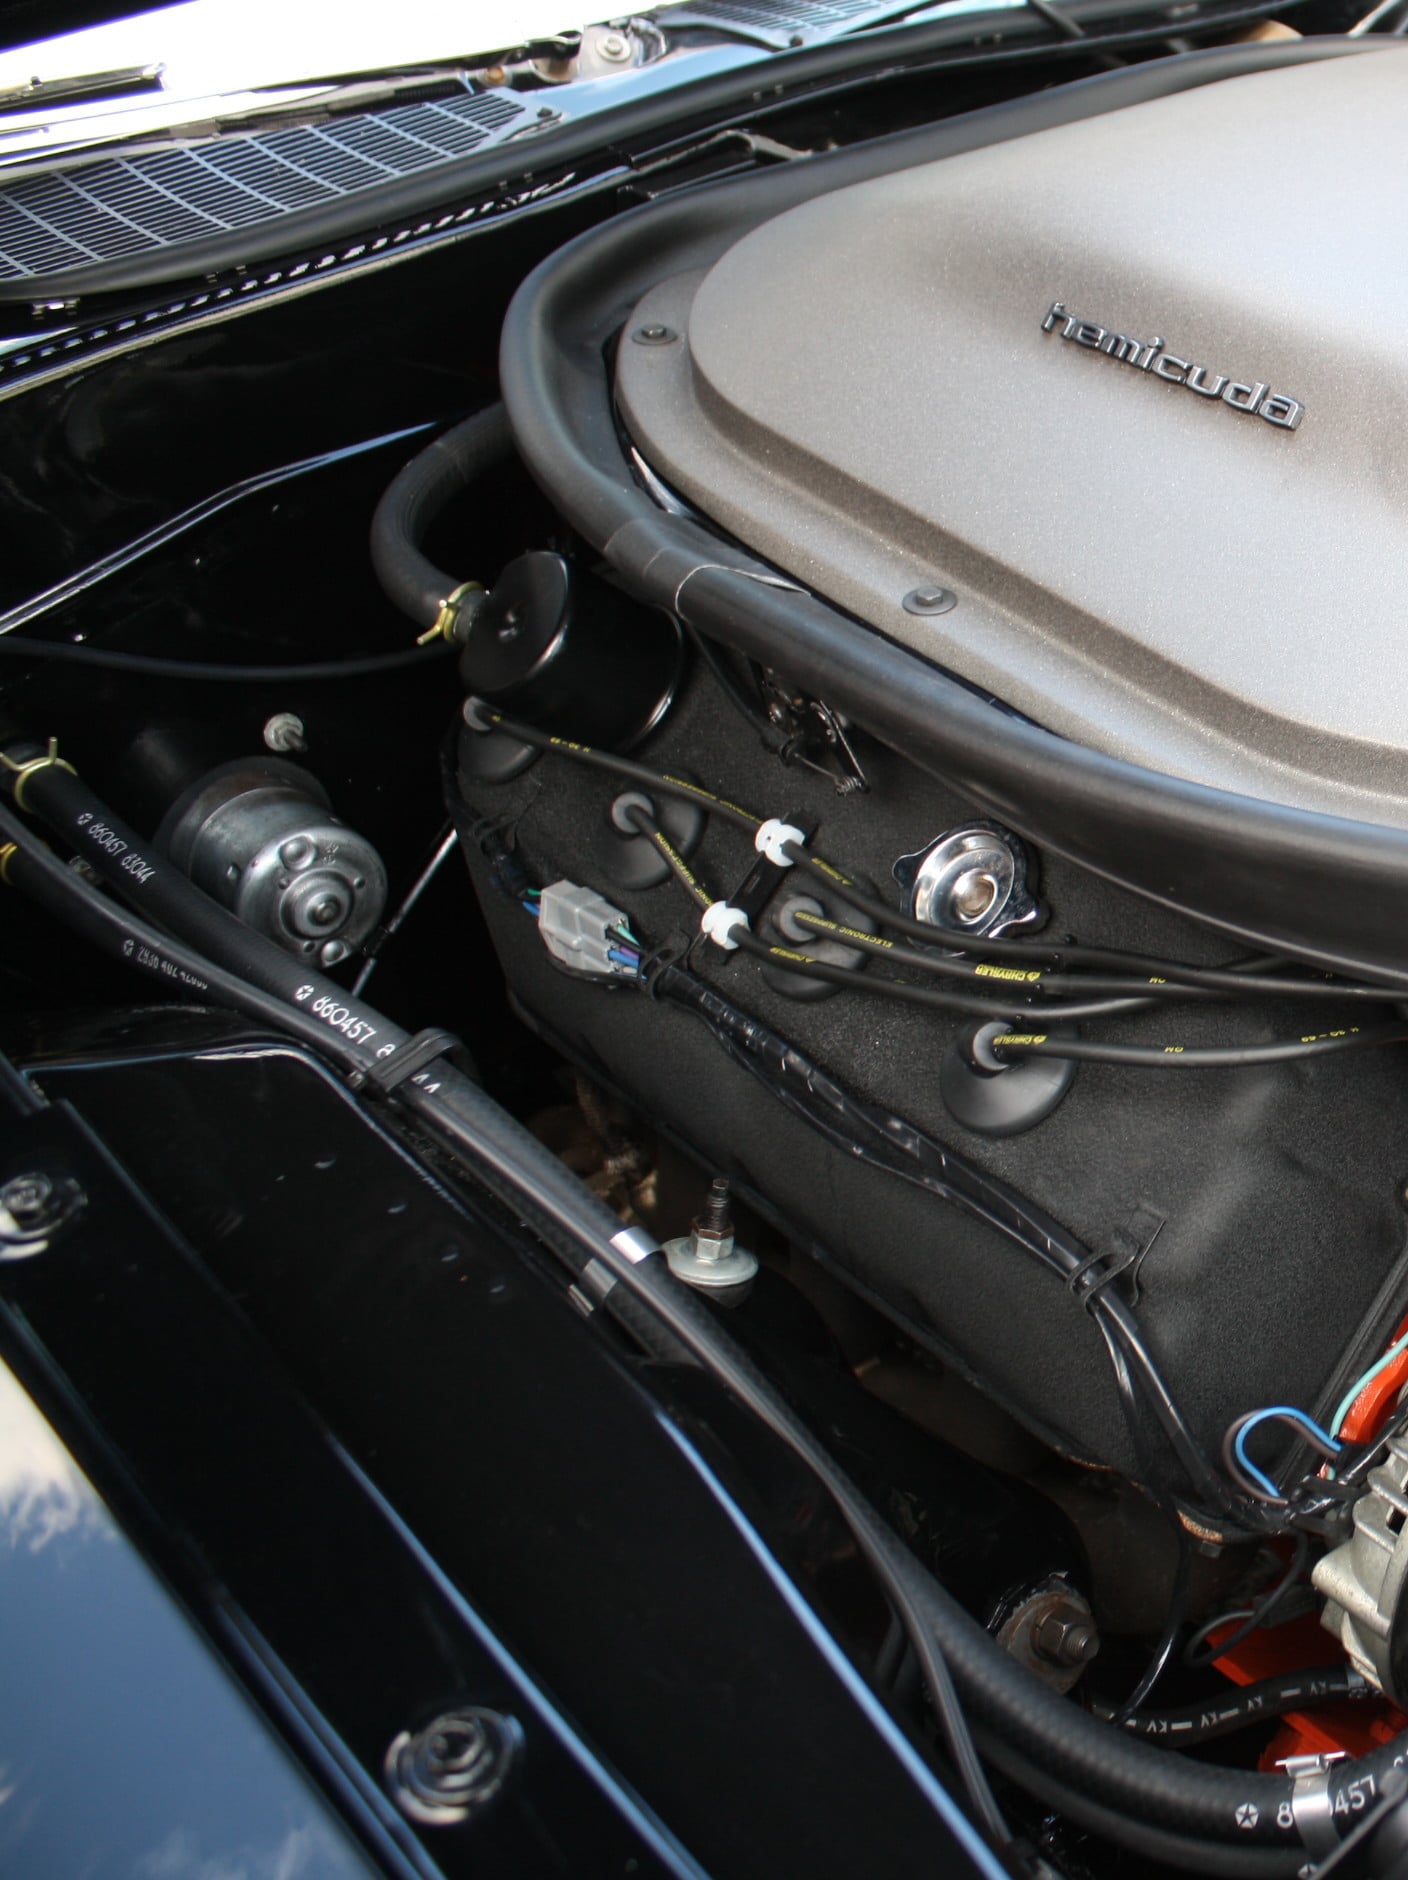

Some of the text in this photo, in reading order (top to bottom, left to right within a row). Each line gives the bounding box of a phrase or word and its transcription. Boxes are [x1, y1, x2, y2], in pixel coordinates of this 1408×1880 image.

[1041, 302, 1306, 430] hemicuda
[88, 822, 128, 856] 860457
[839, 928, 893, 947] ELECTRONIC
[974, 964, 1026, 981] CHRYSLER
[312, 995, 376, 1045] 860457
[1276, 1774, 1376, 1828] 8457
